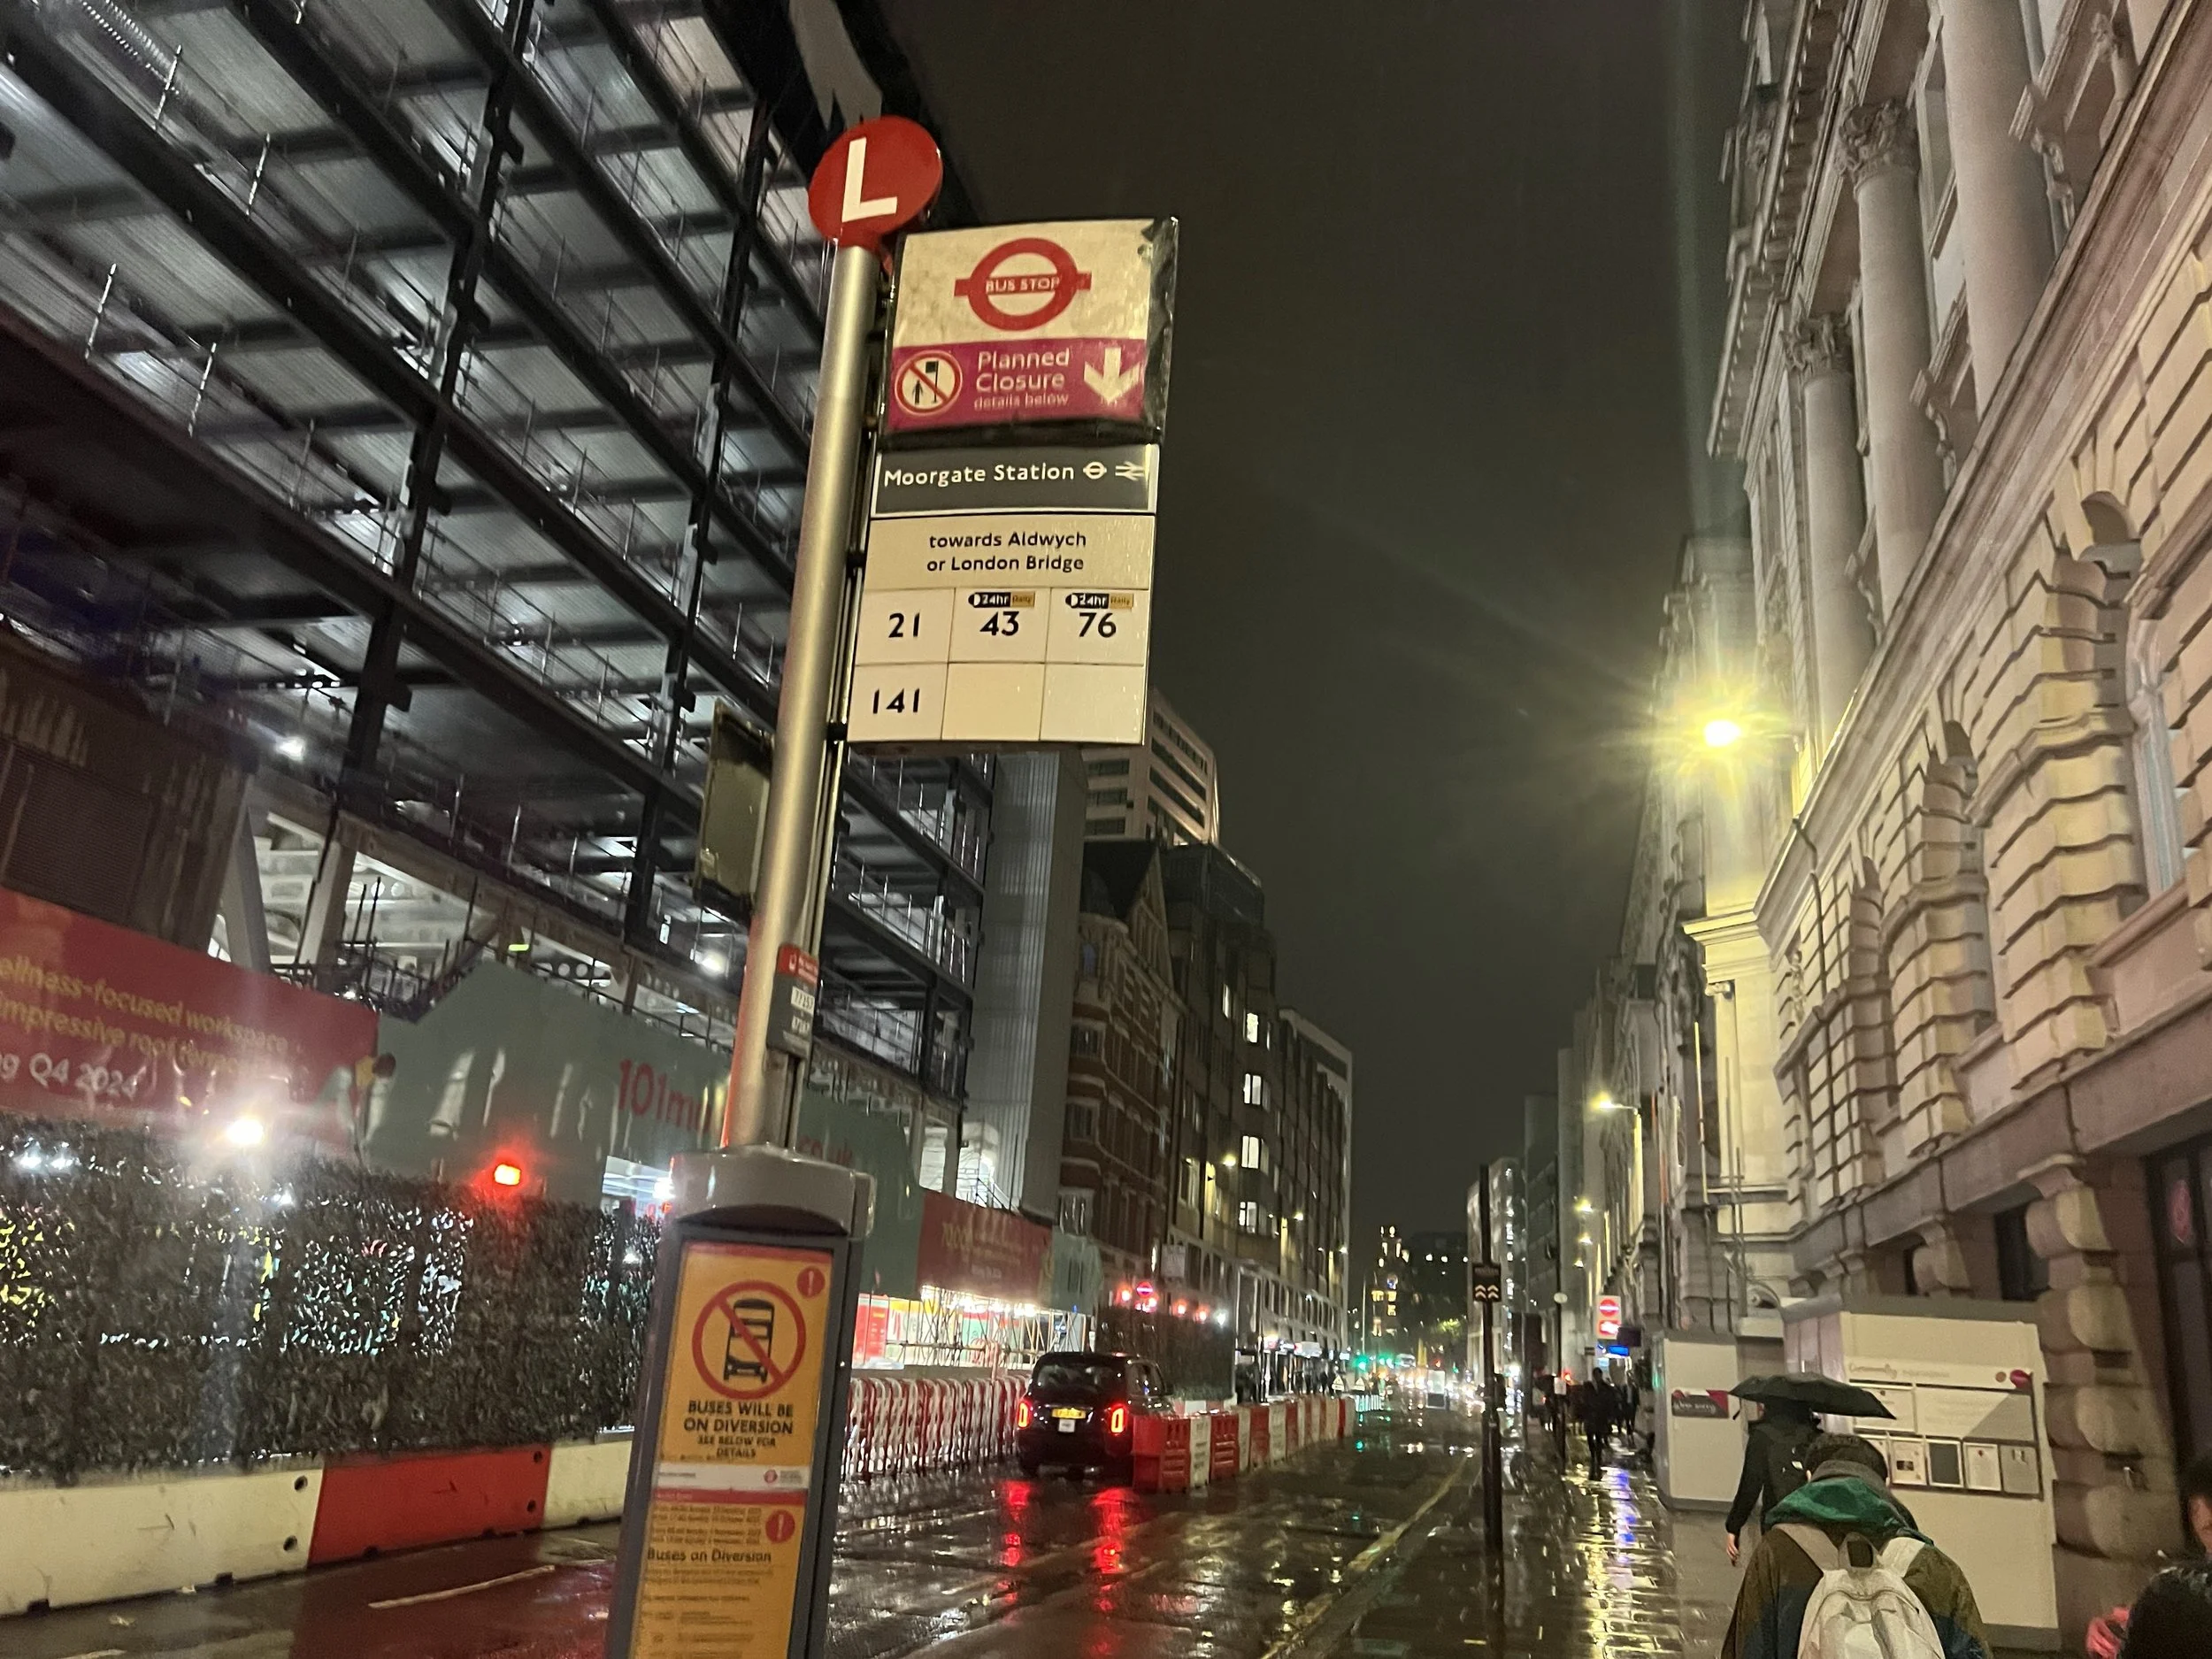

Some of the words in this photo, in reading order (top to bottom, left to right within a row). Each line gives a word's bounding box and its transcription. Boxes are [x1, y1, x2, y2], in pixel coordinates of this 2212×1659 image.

[841, 137, 897, 222] L
[986, 278, 1016, 293] BUS
[1020, 276, 1060, 292] STOP
[978, 347, 1070, 373] Planned
[976, 372, 1065, 392] Closure
[974, 394, 1020, 411] details
[1025, 391, 1069, 408] below
[884, 467, 986, 487] Moorgate
[994, 462, 1075, 480] Station
[929, 533, 1002, 549] towards
[1008, 532, 1087, 550] Aldwych
[926, 559, 946, 572] or
[951, 556, 1019, 571] London
[1026, 556, 1084, 573] Bridge
[981, 594, 1009, 606] 24hr
[1079, 594, 1107, 606] 24hr
[888, 611, 920, 638] 21
[979, 611, 1019, 636] 43
[1079, 612, 1117, 638] 76
[872, 687, 920, 714] 141
[29, 1052, 69, 1087] Q4
[688, 1400, 732, 1415] BUSES
[738, 1401, 772, 1417] WILL
[777, 1403, 794, 1417] BE
[684, 1417, 709, 1432] ON
[713, 1418, 794, 1434] DIVERSION
[718, 1435, 753, 1446] BELOW
[716, 1448, 757, 1458] DETAILS
[647, 1547, 686, 1562] Buses
[690, 1551, 707, 1563] on
[711, 1548, 772, 1563] Diversion
